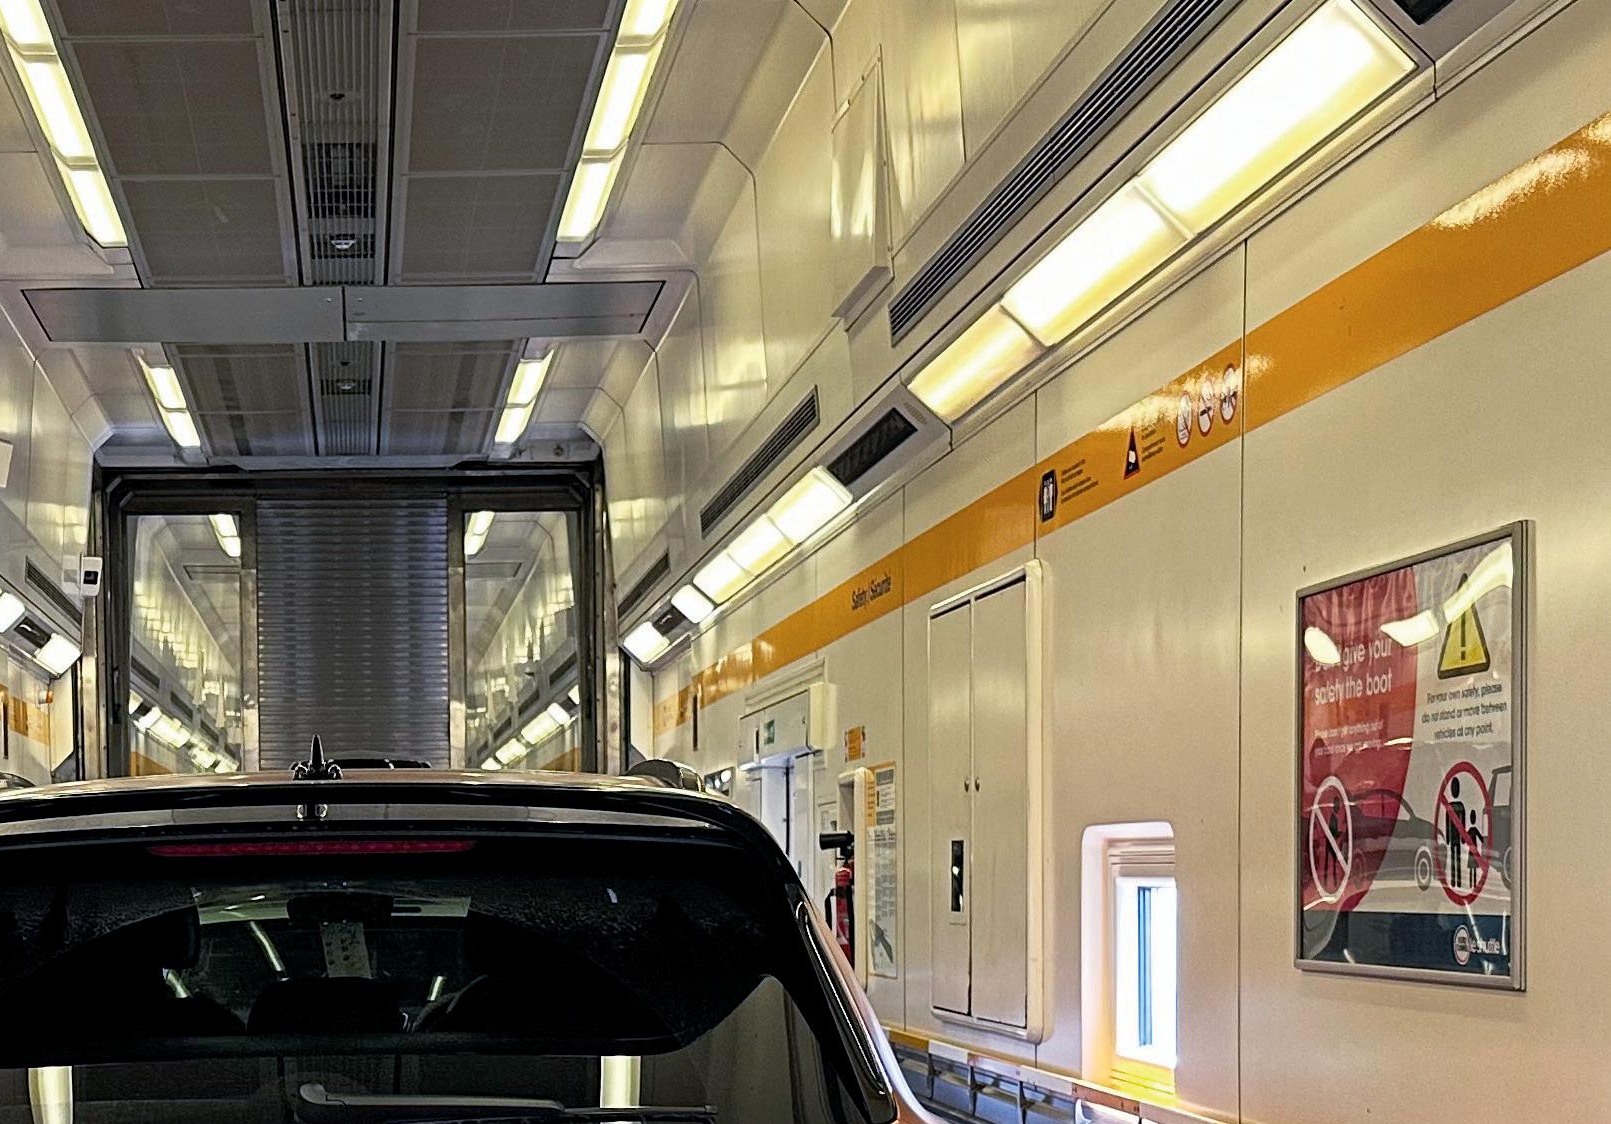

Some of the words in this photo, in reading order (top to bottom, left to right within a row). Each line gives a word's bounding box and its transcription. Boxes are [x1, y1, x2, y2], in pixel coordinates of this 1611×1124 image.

[1342, 642, 1365, 673] give
[1368, 637, 1394, 668] your
[1314, 678, 1345, 706] safety
[1345, 675, 1364, 700] the
[1366, 667, 1393, 696] boot
[1481, 702, 1508, 715] between
